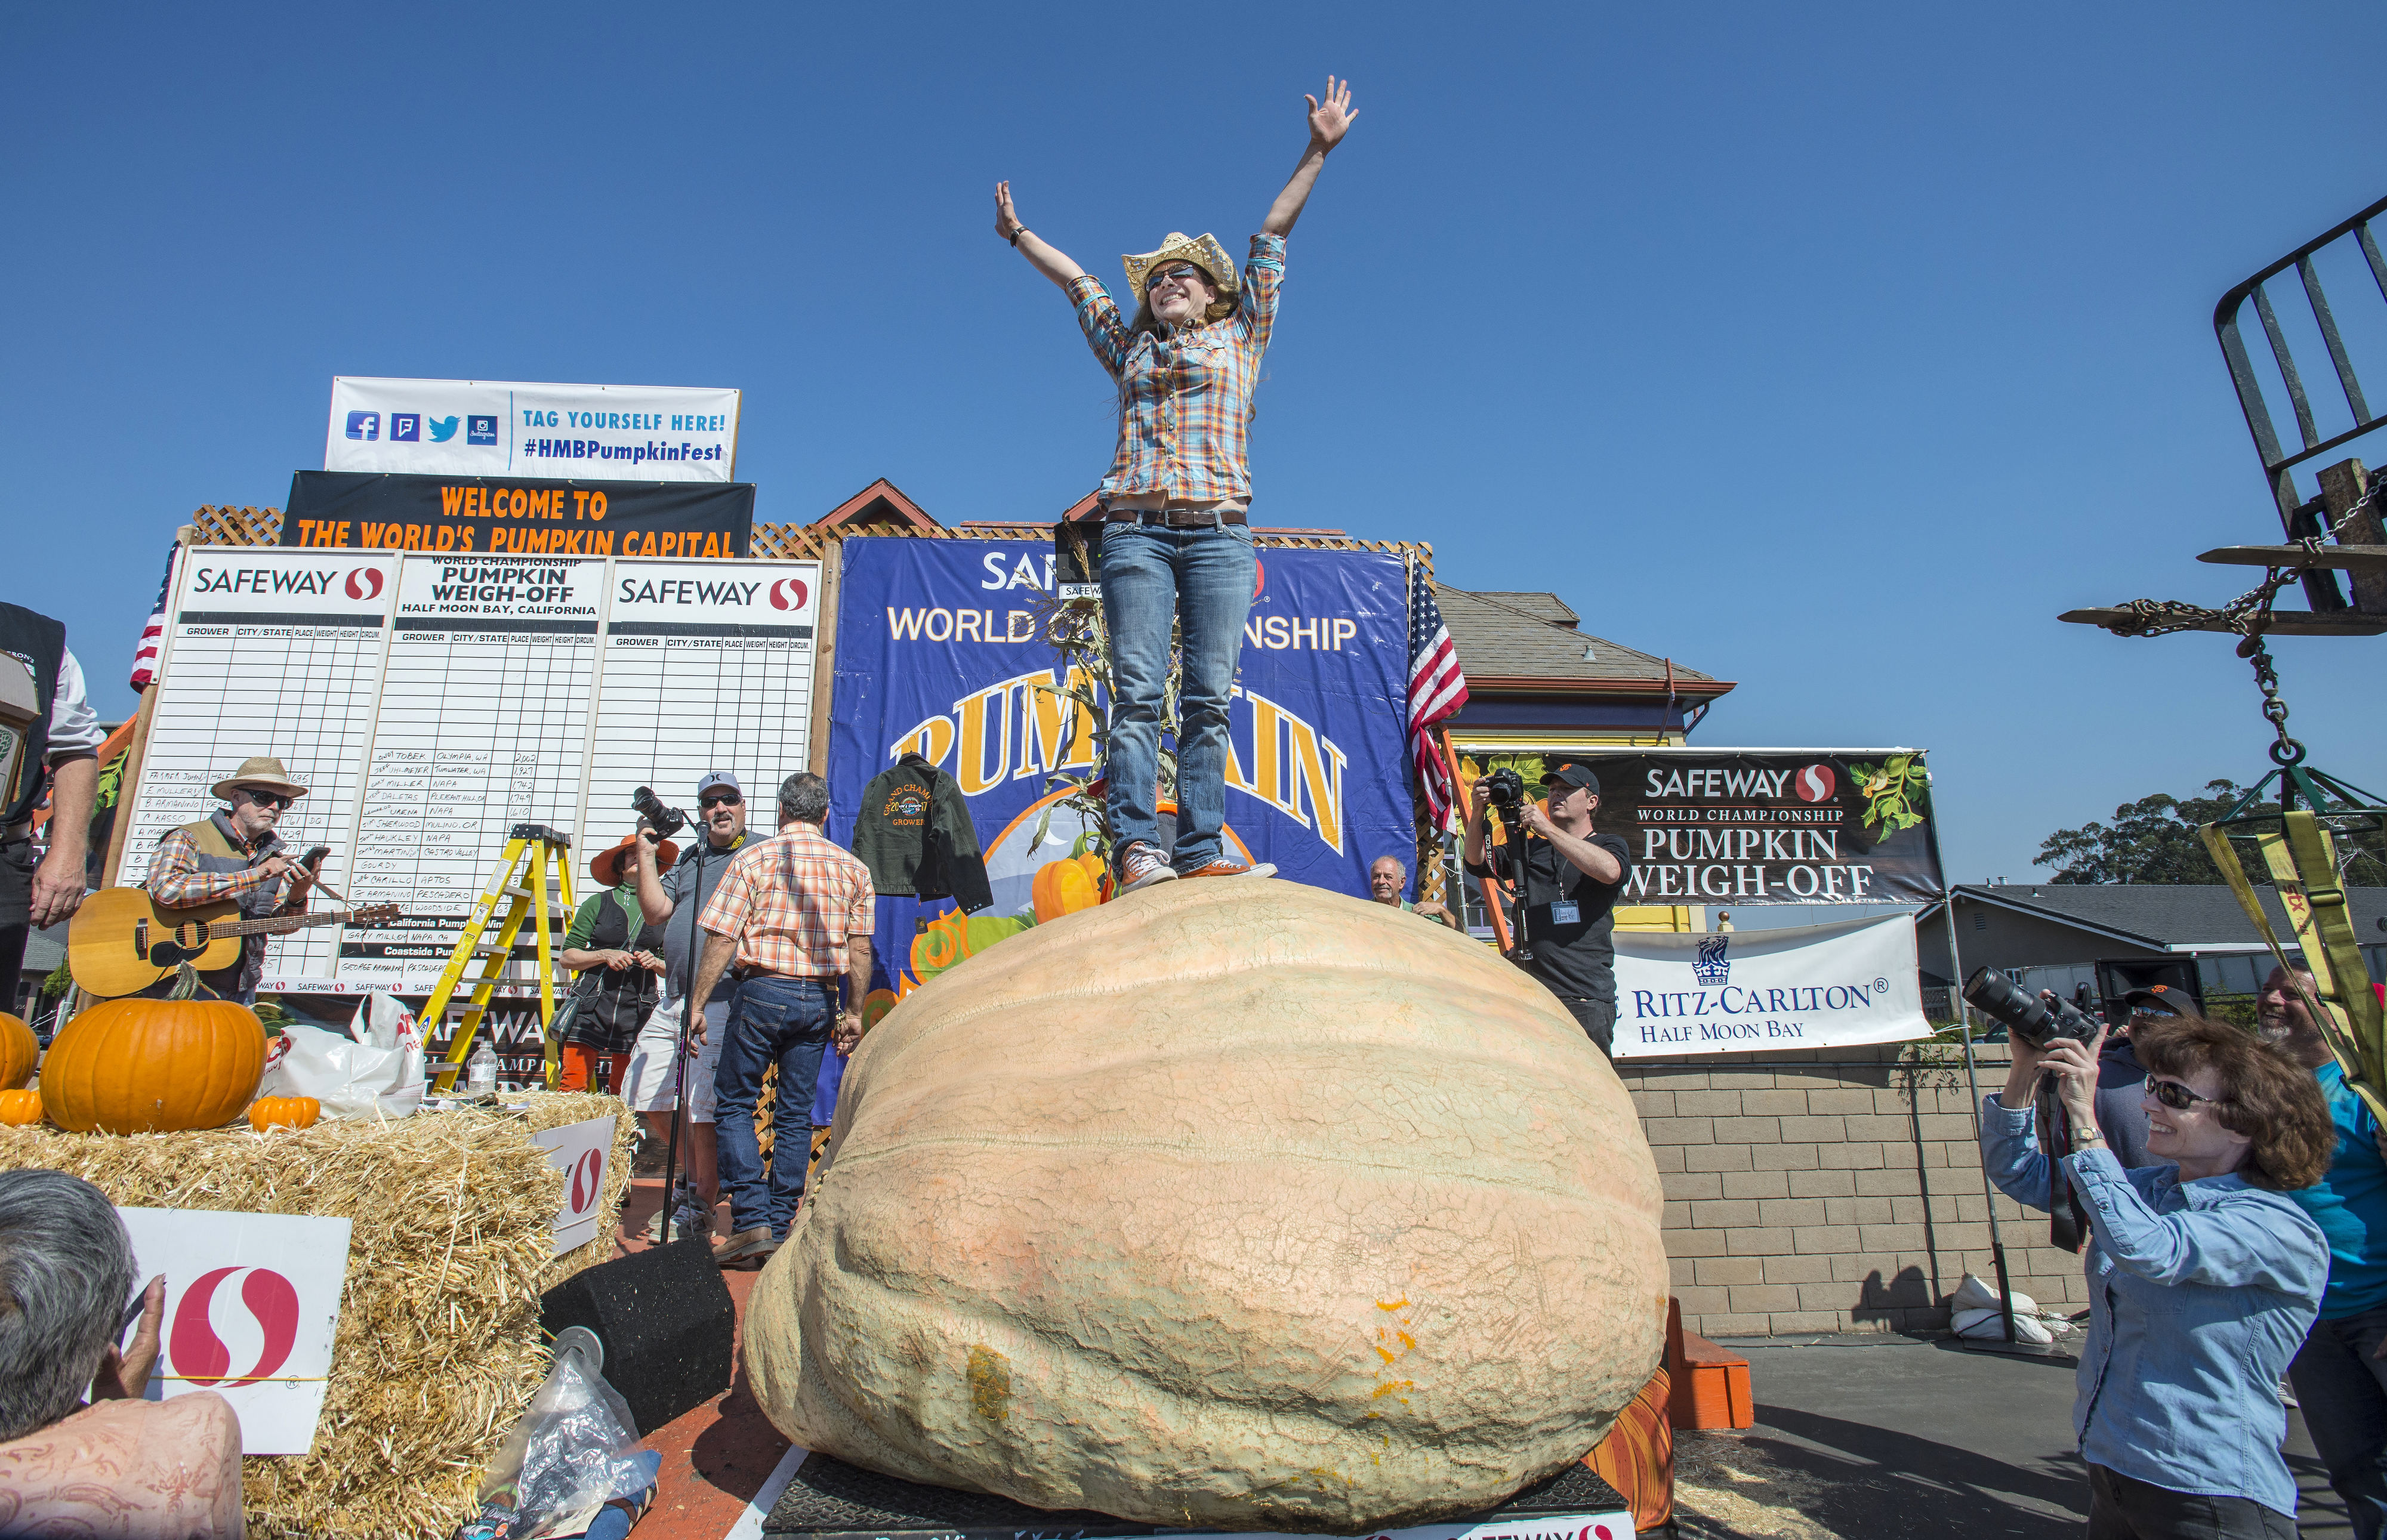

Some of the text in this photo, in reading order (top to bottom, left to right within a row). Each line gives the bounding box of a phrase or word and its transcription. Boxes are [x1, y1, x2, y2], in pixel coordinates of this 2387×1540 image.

[523, 410, 726, 431] TAG YOURSELF HERE!
[470, 430, 495, 440] Instagram
[525, 438, 722, 465] #HMBPumpkinFest
[441, 486, 607, 521] WELCOME TO
[298, 519, 734, 558] THE WORLD'S PUMPKIN CAPITAL
[432, 556, 582, 567] WORLD CHAMPIONSHIP
[193, 567, 338, 595] SAFEWAY
[442, 567, 567, 585] PUMPKIN
[431, 585, 574, 603] WEIGH-OFF
[619, 578, 762, 606] SAFEWAY
[402, 604, 597, 615] HALF MOON BAY, CALIFORNIA
[887, 606, 1036, 643] WORLD
[238, 628, 292, 637] CITY/STATE
[316, 629, 337, 638] WEIGHT
[453, 634, 508, 643] CITY/STATE
[667, 639, 721, 648] CITY/STATE
[476, 753, 488, 761] WA
[374, 763, 390, 774] JEFF
[149, 771, 180, 781] FARMER
[1645, 768, 1791, 798] SAFEWAY
[366, 789, 418, 801] STEVE DALETAS
[430, 792, 461, 801] PLEASANT
[156, 799, 199, 808] ARMANINO
[883, 787, 903, 816] GRAND
[890, 801, 899, 811] 20
[921, 801, 927, 811] 17
[430, 806, 454, 815] NAPA
[1637, 809, 1844, 822] WORLD CHAMPIONSHIP
[154, 814, 186, 823] KASSO
[363, 819, 421, 829] JIM SHERWOOD
[462, 821, 477, 829] OR
[359, 832, 418, 844] JOHN HAWKLEY
[426, 834, 451, 842] NAPA
[1643, 828, 1839, 861] PUMPKIN
[357, 845, 375, 855] JAMES
[424, 848, 453, 857] CASTRO
[455, 848, 479, 858] VALLEY
[361, 860, 397, 871] GOURDY
[354, 874, 412, 884] LUPE CARILLO
[421, 876, 451, 884] APTOS
[1623, 865, 1874, 896] WEIGH-OFF
[417, 890, 470, 900] PESCADERO
[438, 918, 470, 930] Pump
[348, 932, 408, 942] GARY MILLER
[384, 946, 433, 956] Coastside
[341, 963, 372, 971] GEORGE
[297, 983, 334, 991] SAFEWAY
[414, 984, 436, 992] SAFE
[1640, 1020, 1804, 1043] HALF MOON BAY
